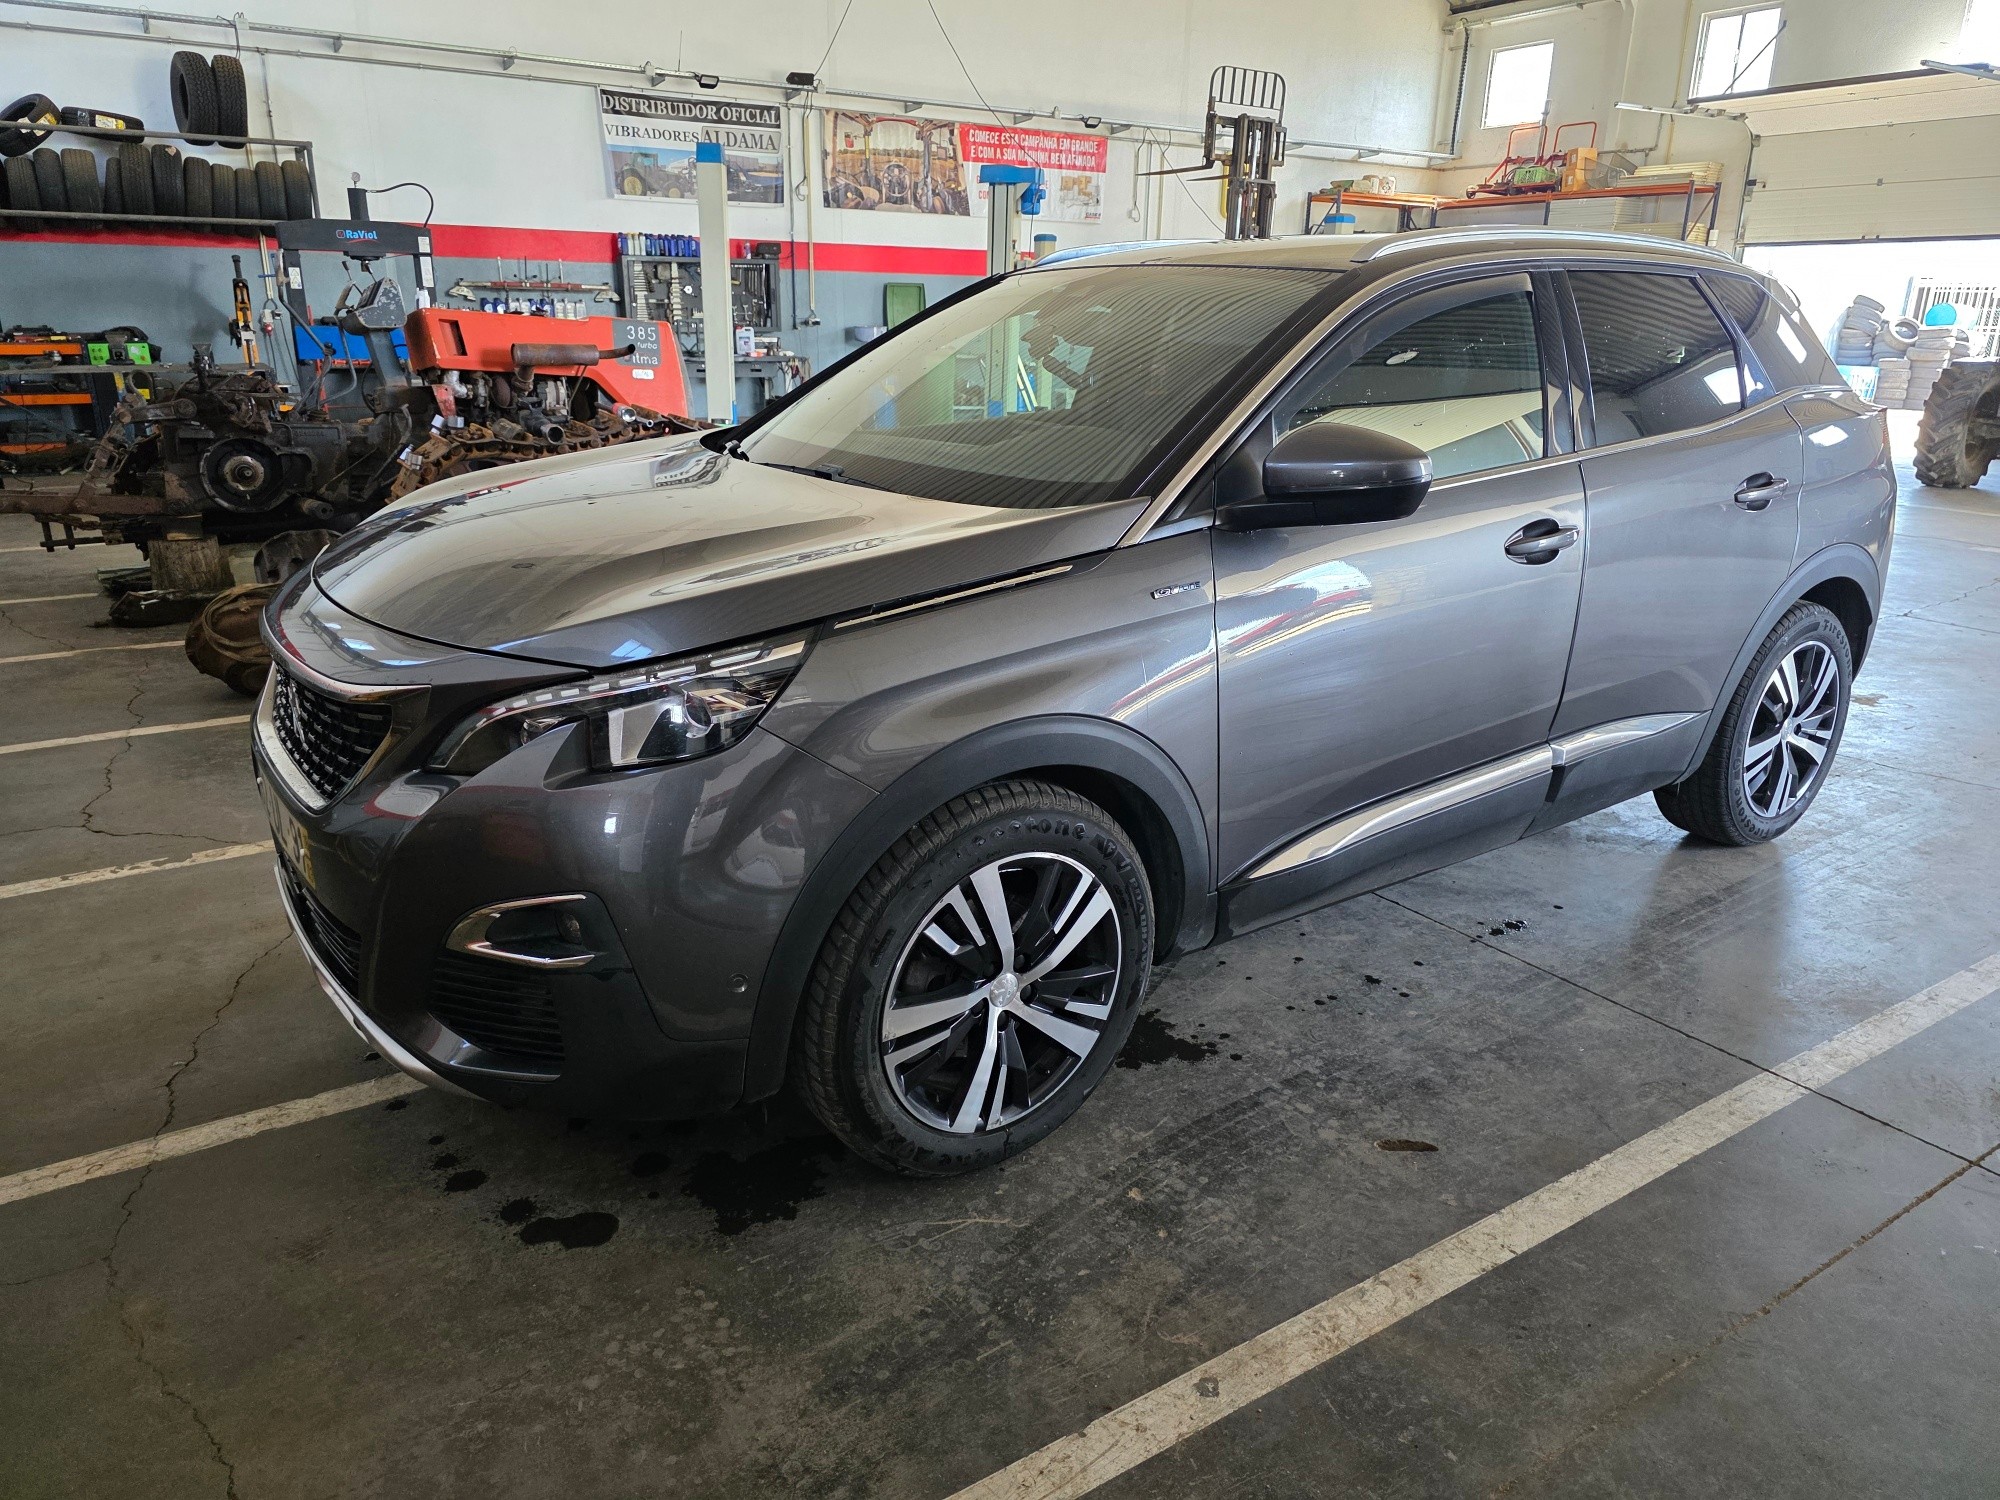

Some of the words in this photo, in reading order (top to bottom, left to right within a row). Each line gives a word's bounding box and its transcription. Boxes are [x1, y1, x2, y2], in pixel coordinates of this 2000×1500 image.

[602, 94, 717, 119] DISTRIBUIDOR
[720, 106, 780, 125] OFICIAL
[605, 123, 699, 143] VIBRADORES
[703, 129, 776, 151] ALDAMA
[969, 129, 1000, 143] COMECE
[1001, 132, 1019, 146] ESTA
[1020, 135, 1058, 150] CAMPANHA
[1059, 139, 1070, 151] EM
[1071, 140, 1098, 153] GRANDE
[971, 145, 977, 158] E
[978, 145, 995, 159] COM
[996, 148, 1002, 160] A
[1003, 149, 1017, 161] SUA
[1050, 152, 1066, 166] BEM
[1067, 153, 1096, 168] AFINADA
[345, 229, 378, 239] RaViol
[626, 325, 656, 341] 385
[637, 341, 658, 350] turbo
[1823, 619, 1852, 679] Firestone
[1734, 787, 1770, 839] Firestone
